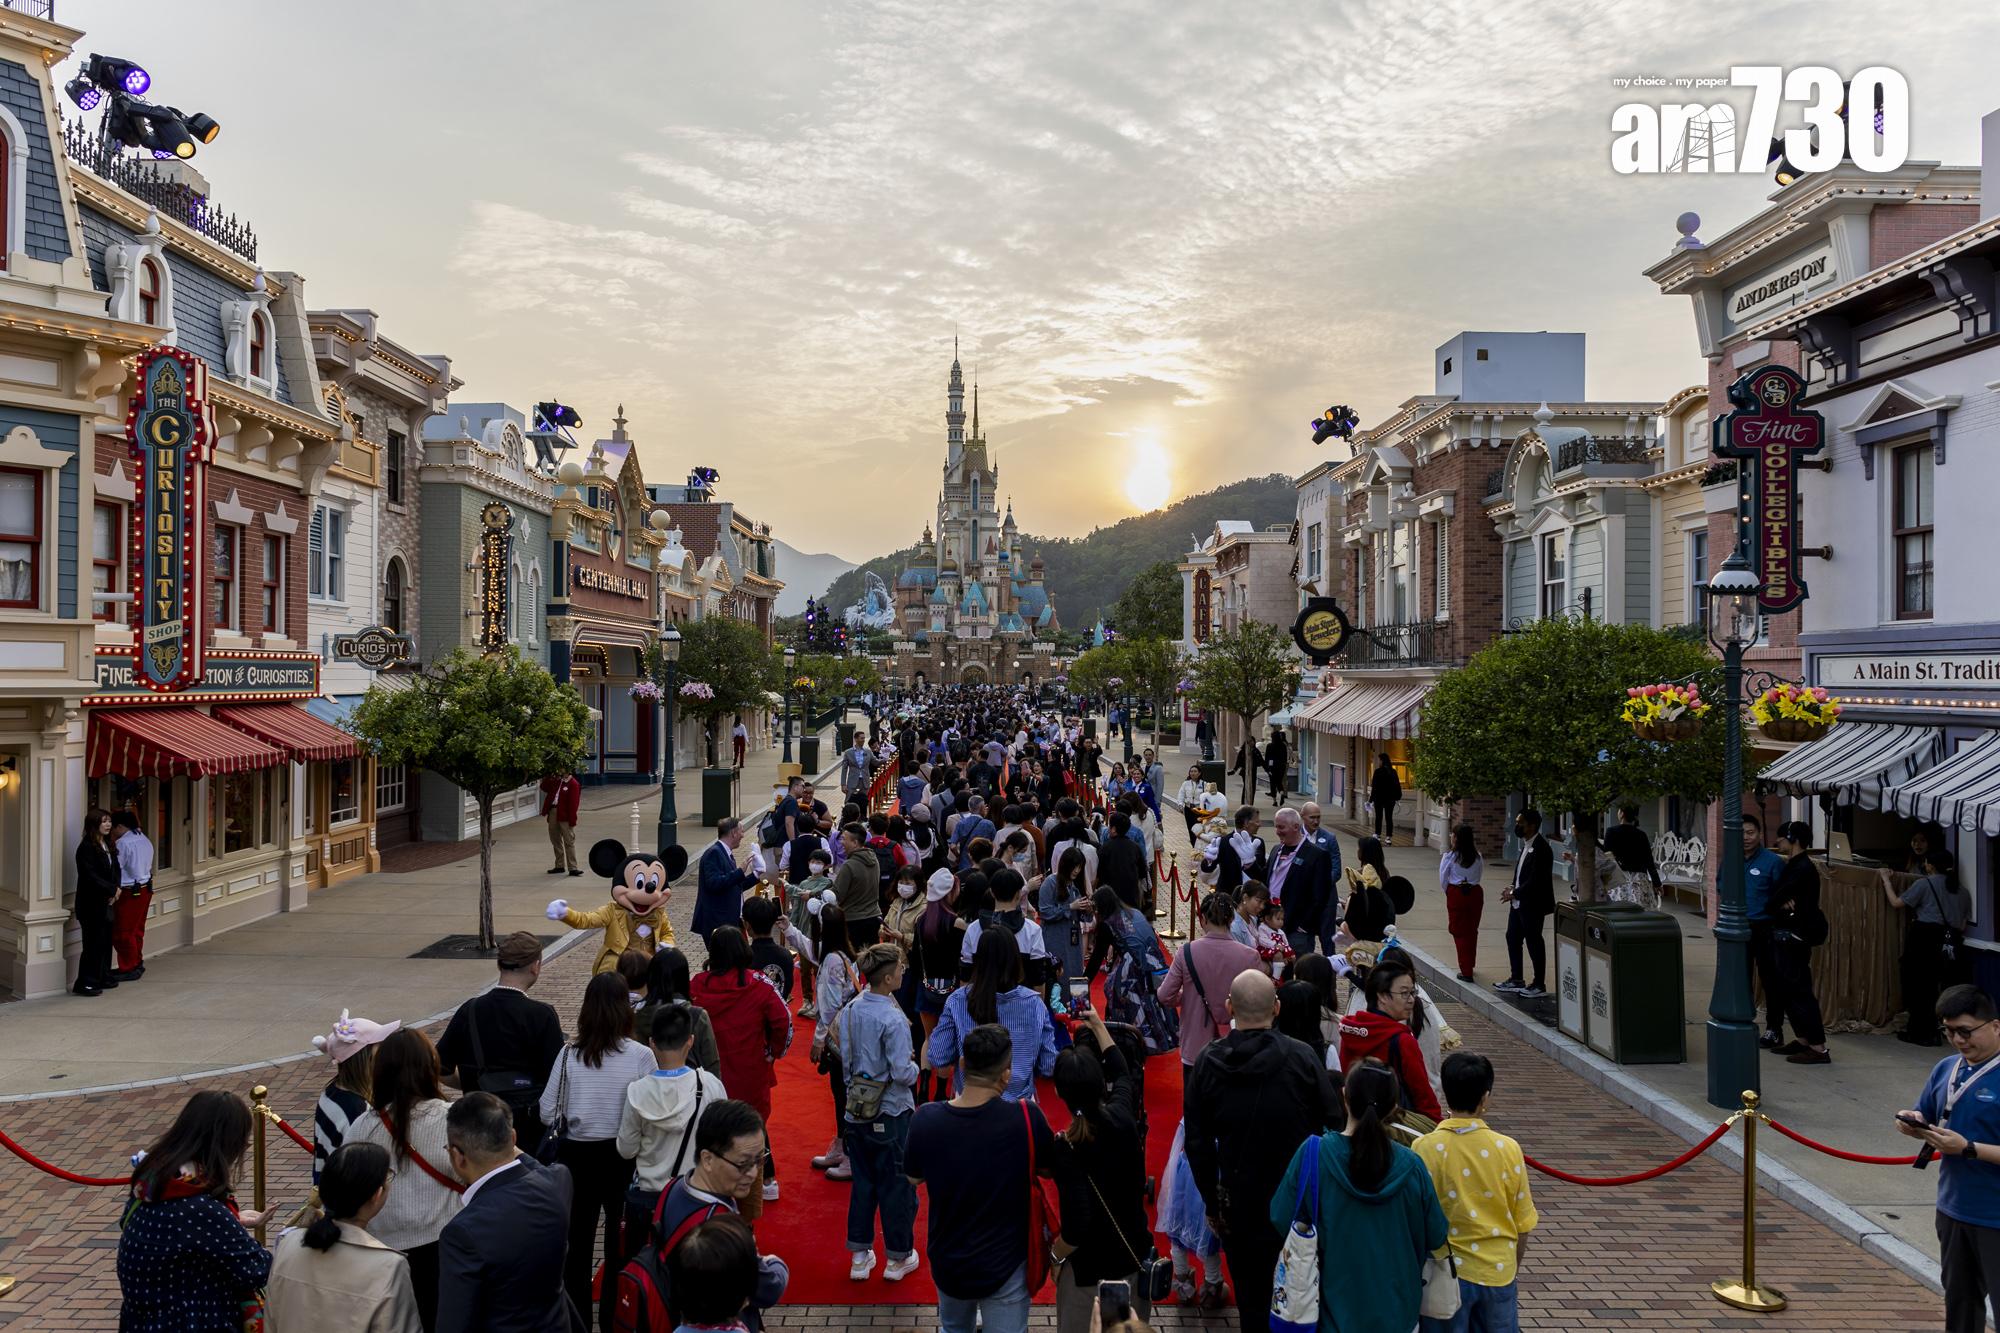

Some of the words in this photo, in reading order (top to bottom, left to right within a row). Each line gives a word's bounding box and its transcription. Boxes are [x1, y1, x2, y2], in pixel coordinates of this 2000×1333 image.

[1735, 256, 1827, 313] ANDERSON
[158, 398, 177, 408] THE
[1742, 419, 1812, 443] Fine
[151, 415, 181, 621] CURIOSITY
[1764, 443, 1787, 599] COLLECTIBLES
[488, 534, 500, 645] CENTENNIAL
[580, 566, 632, 596] CENTENNIAL
[632, 579, 649, 600] HALL
[148, 624, 182, 640] SHOP
[342, 640, 405, 656] CURIOSITY
[247, 666, 308, 685] CURIOSITIES
[1853, 663, 1865, 680] A
[1869, 661, 1910, 680] Main
[1915, 661, 1938, 680] St.
